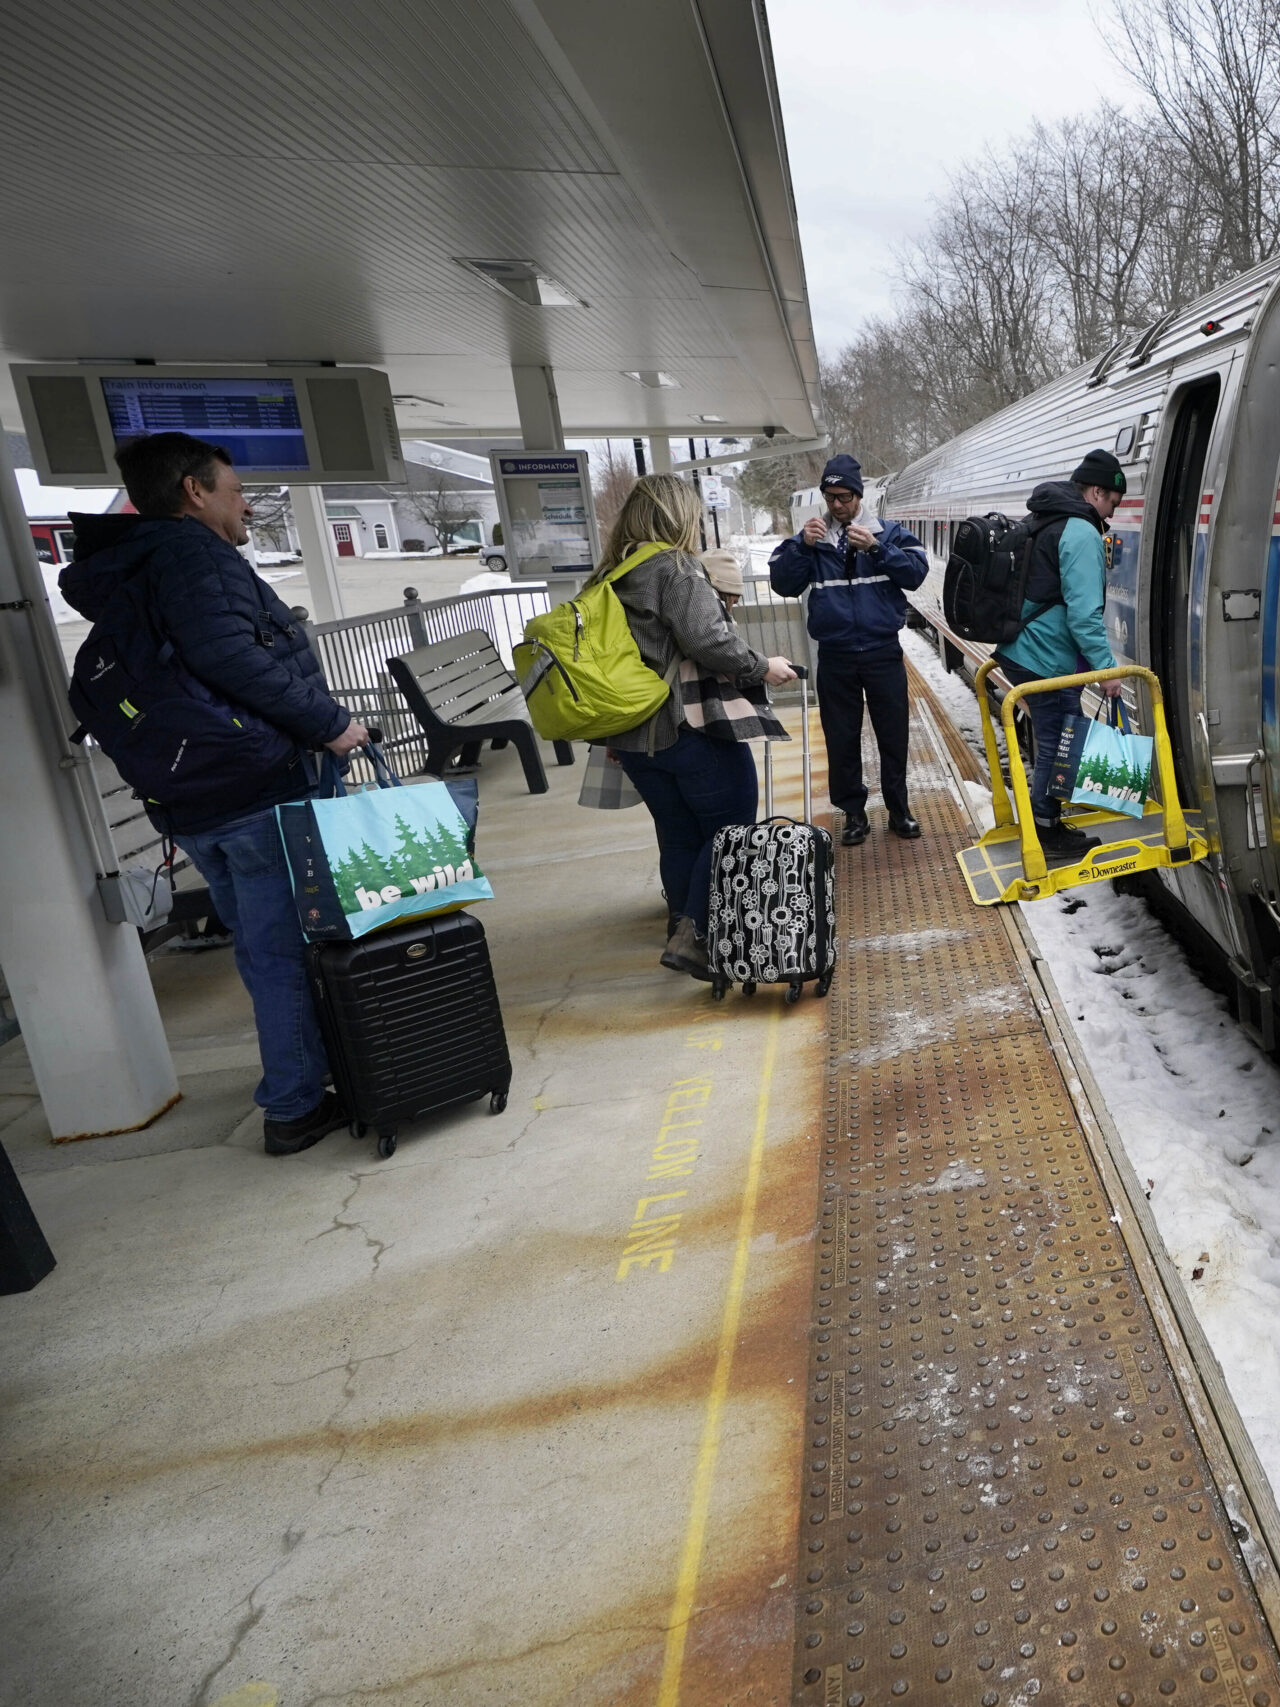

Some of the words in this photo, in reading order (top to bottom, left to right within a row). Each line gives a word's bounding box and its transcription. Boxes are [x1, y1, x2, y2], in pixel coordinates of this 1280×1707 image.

[103, 380, 135, 390] Train
[138, 380, 206, 391] Information
[518, 463, 576, 471] INFORMATION
[543, 512, 572, 521] Schedule
[1082, 776, 1103, 793] be
[1106, 785, 1142, 803] wild
[1091, 859, 1137, 879] Downeaster
[354, 885, 402, 911] be
[408, 858, 474, 895] wild
[645, 1071, 714, 1181] YELLOW
[615, 1189, 688, 1283] LINE
[833, 1376, 845, 1417] COMPANY
[832, 1422, 844, 1465] FOUNDRY
[831, 1470, 844, 1512] NEENAH
[1209, 1624, 1228, 1652] USA
[1219, 1657, 1235, 1672] IN
[1226, 1677, 1246, 1707] ADE
